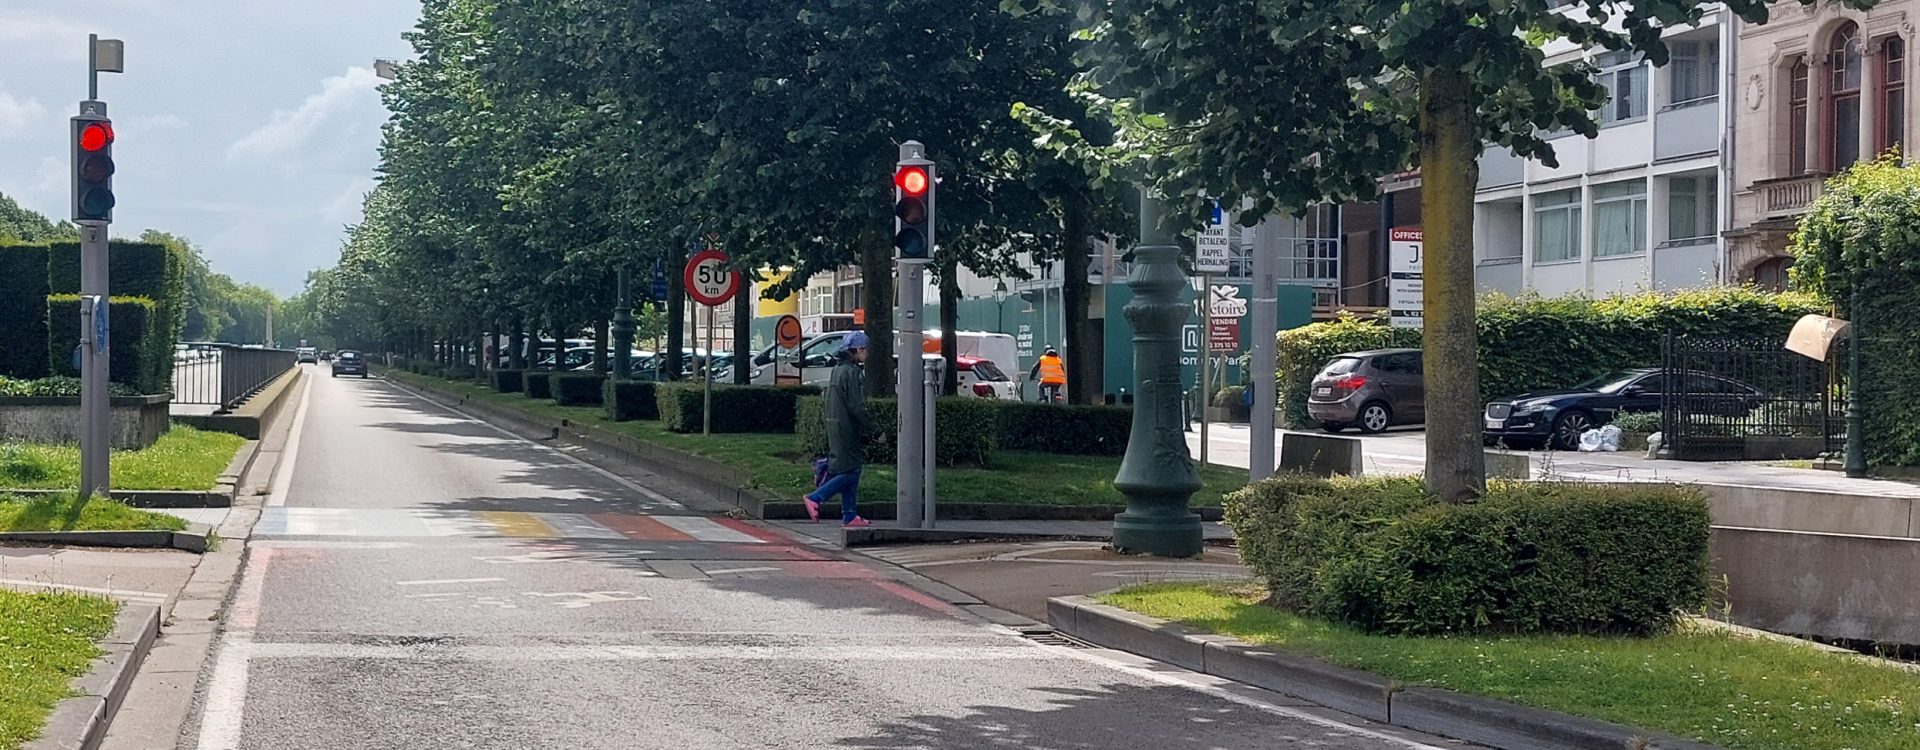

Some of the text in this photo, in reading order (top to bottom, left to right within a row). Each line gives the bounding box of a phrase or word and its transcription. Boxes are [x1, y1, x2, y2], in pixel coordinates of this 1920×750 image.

[1199, 237, 1228, 246] BETALEND
[1202, 248, 1223, 257] RAPPEL
[698, 265, 727, 285] 50
[704, 285, 719, 295] km
[1210, 303, 1246, 315] ctoire
